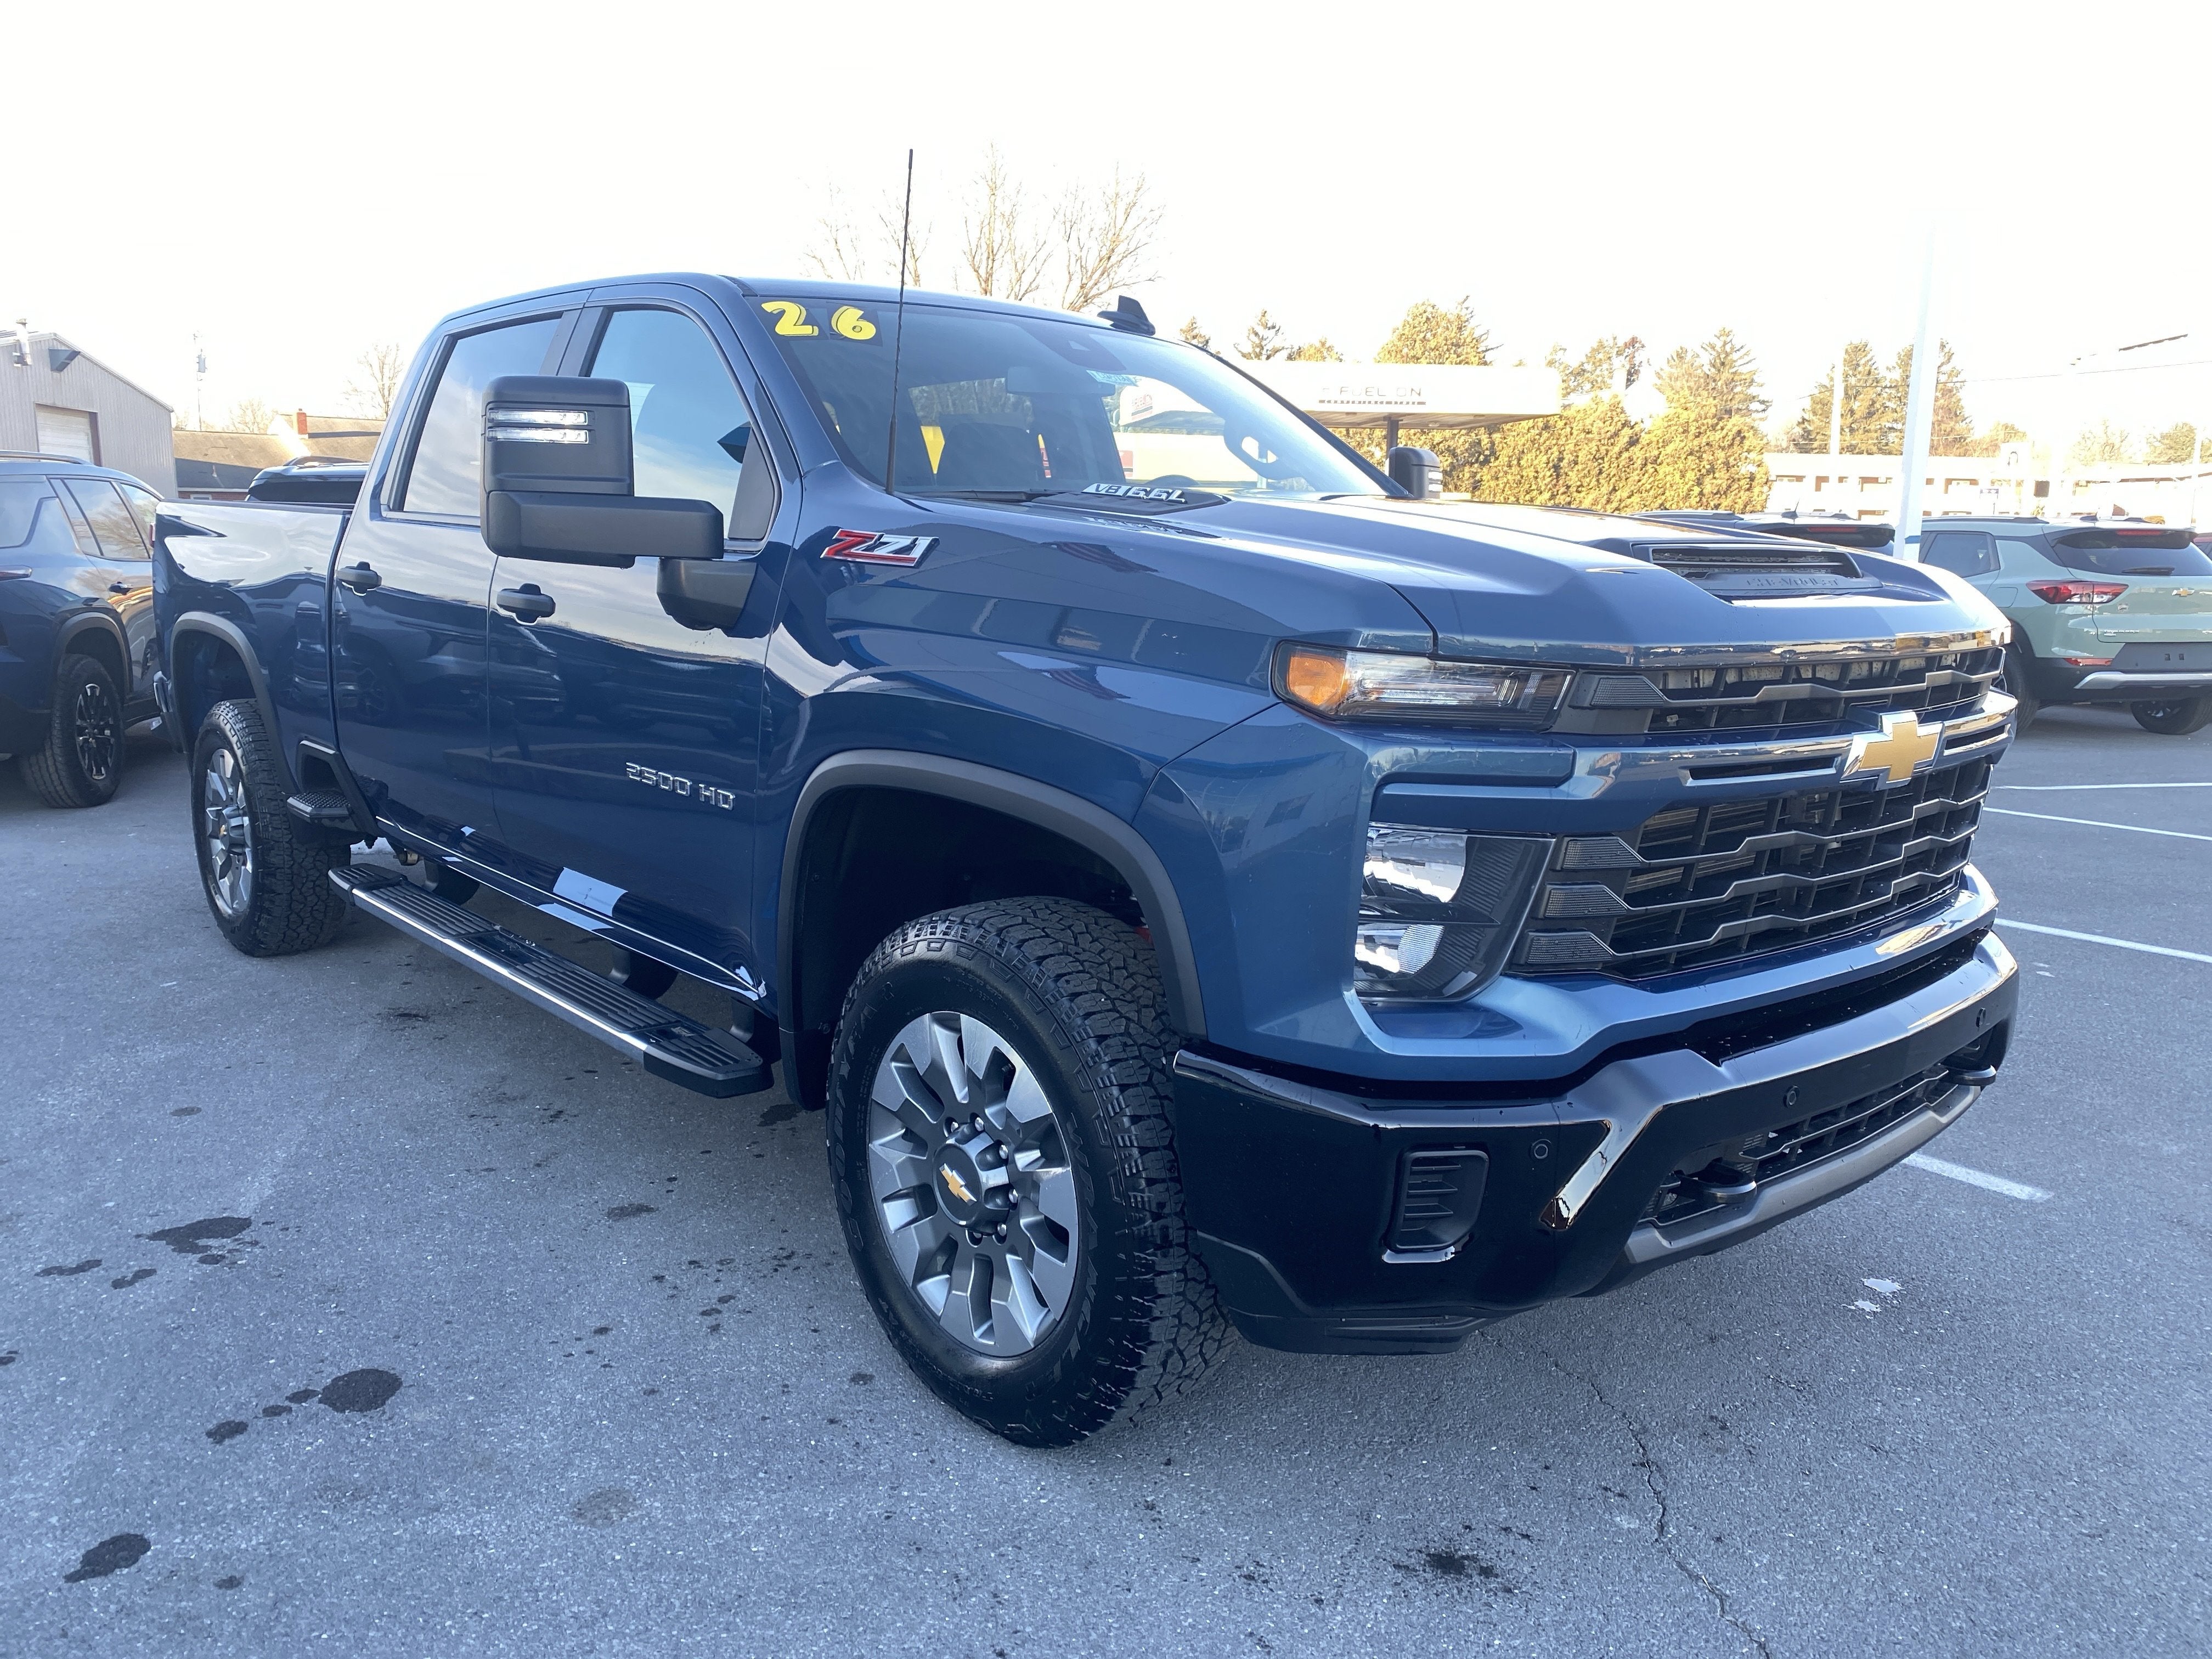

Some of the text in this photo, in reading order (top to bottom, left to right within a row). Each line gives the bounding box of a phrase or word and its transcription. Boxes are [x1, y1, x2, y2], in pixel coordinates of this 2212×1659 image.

[761, 301, 876, 340] 26
[1340, 386, 1387, 397] FUEL
[1396, 387, 1421, 397] ON
[1095, 484, 1187, 504] V8 6.6L
[820, 528, 940, 567] Z71
[626, 762, 736, 811] 2500 HD
